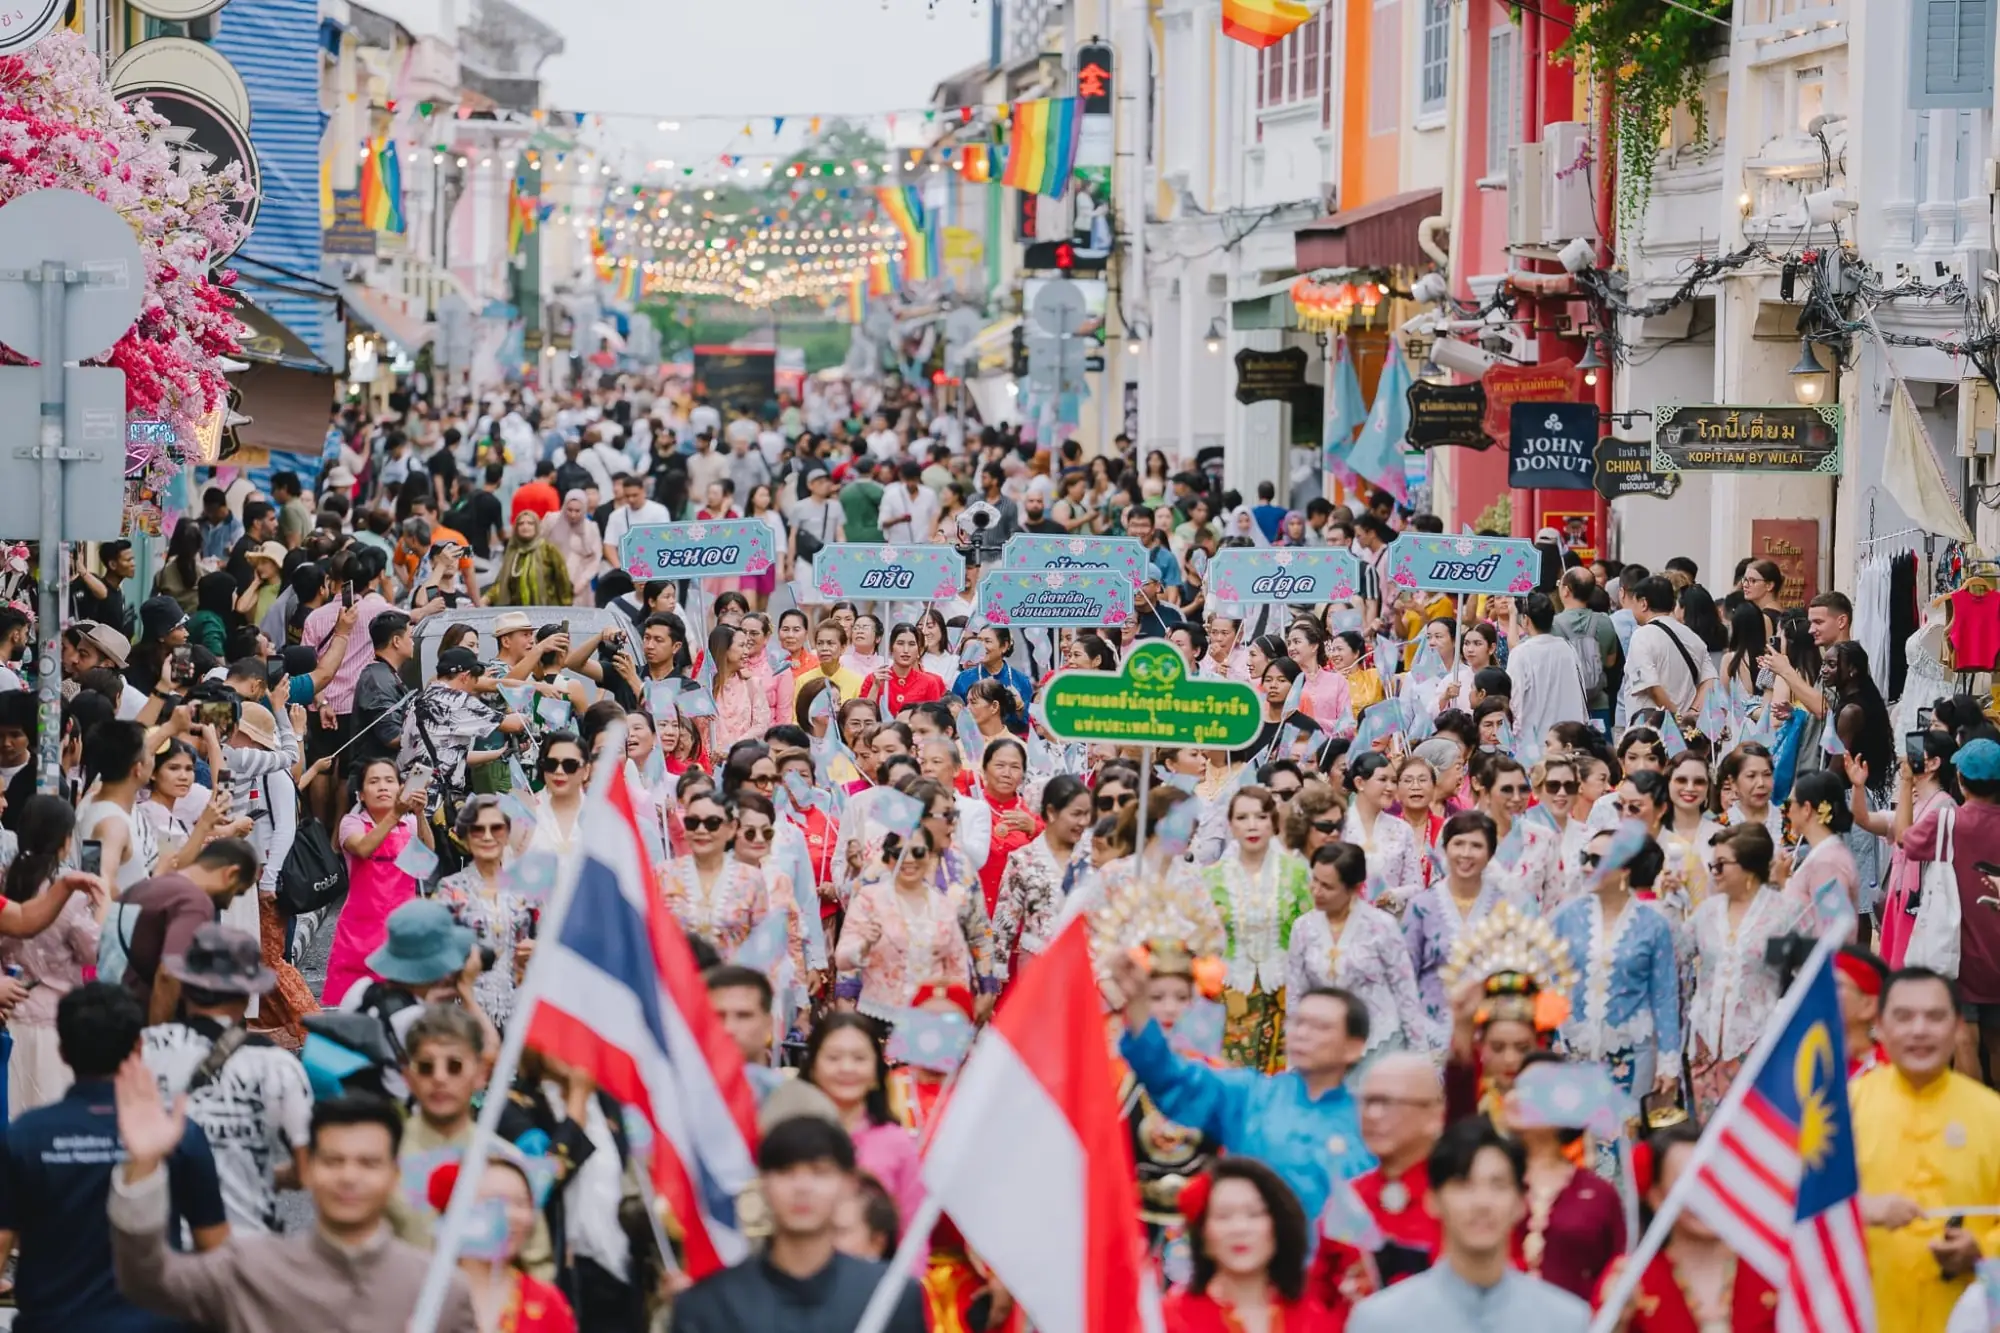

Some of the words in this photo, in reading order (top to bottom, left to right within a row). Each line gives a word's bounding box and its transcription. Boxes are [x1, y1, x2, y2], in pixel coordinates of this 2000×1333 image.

[1523, 437, 1585, 455] JOHN
[1515, 455, 1592, 473] DONUT
[1605, 460, 1642, 473] CHINA
[1688, 452, 1745, 464] KOPITIAM
[1750, 452, 1764, 463] BY
[1768, 452, 1803, 464] WILAI
[1619, 481, 1656, 491] restaurant
[657, 546, 738, 568] ระนอง
[860, 566, 914, 588] ตรัง
[1429, 554, 1501, 582] กระบี่
[1252, 567, 1316, 598] สตูล
[1039, 590, 1085, 604] จังหวัด
[1011, 598, 1102, 618] ชายแดนภาคใต้
